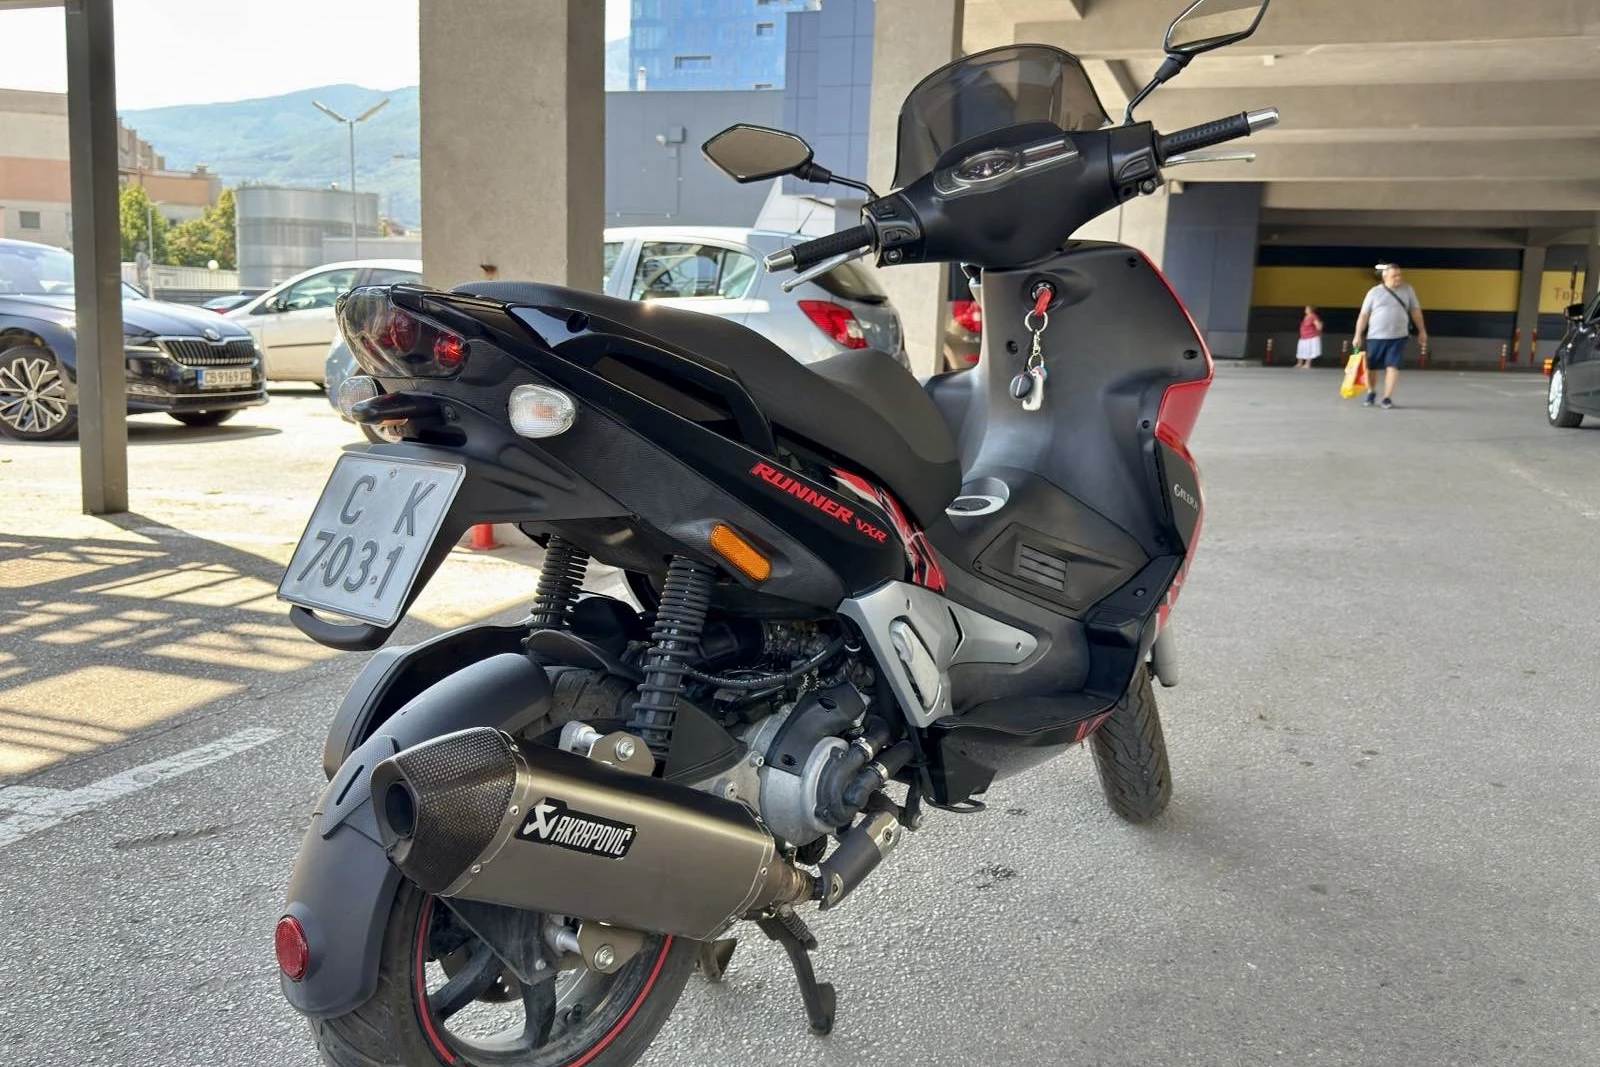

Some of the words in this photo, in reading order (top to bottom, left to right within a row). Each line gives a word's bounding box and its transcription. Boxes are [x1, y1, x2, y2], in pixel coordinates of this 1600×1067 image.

[750, 462, 854, 525] RUNNER
[854, 517, 888, 543] VXR
[297, 530, 406, 600] 7031
